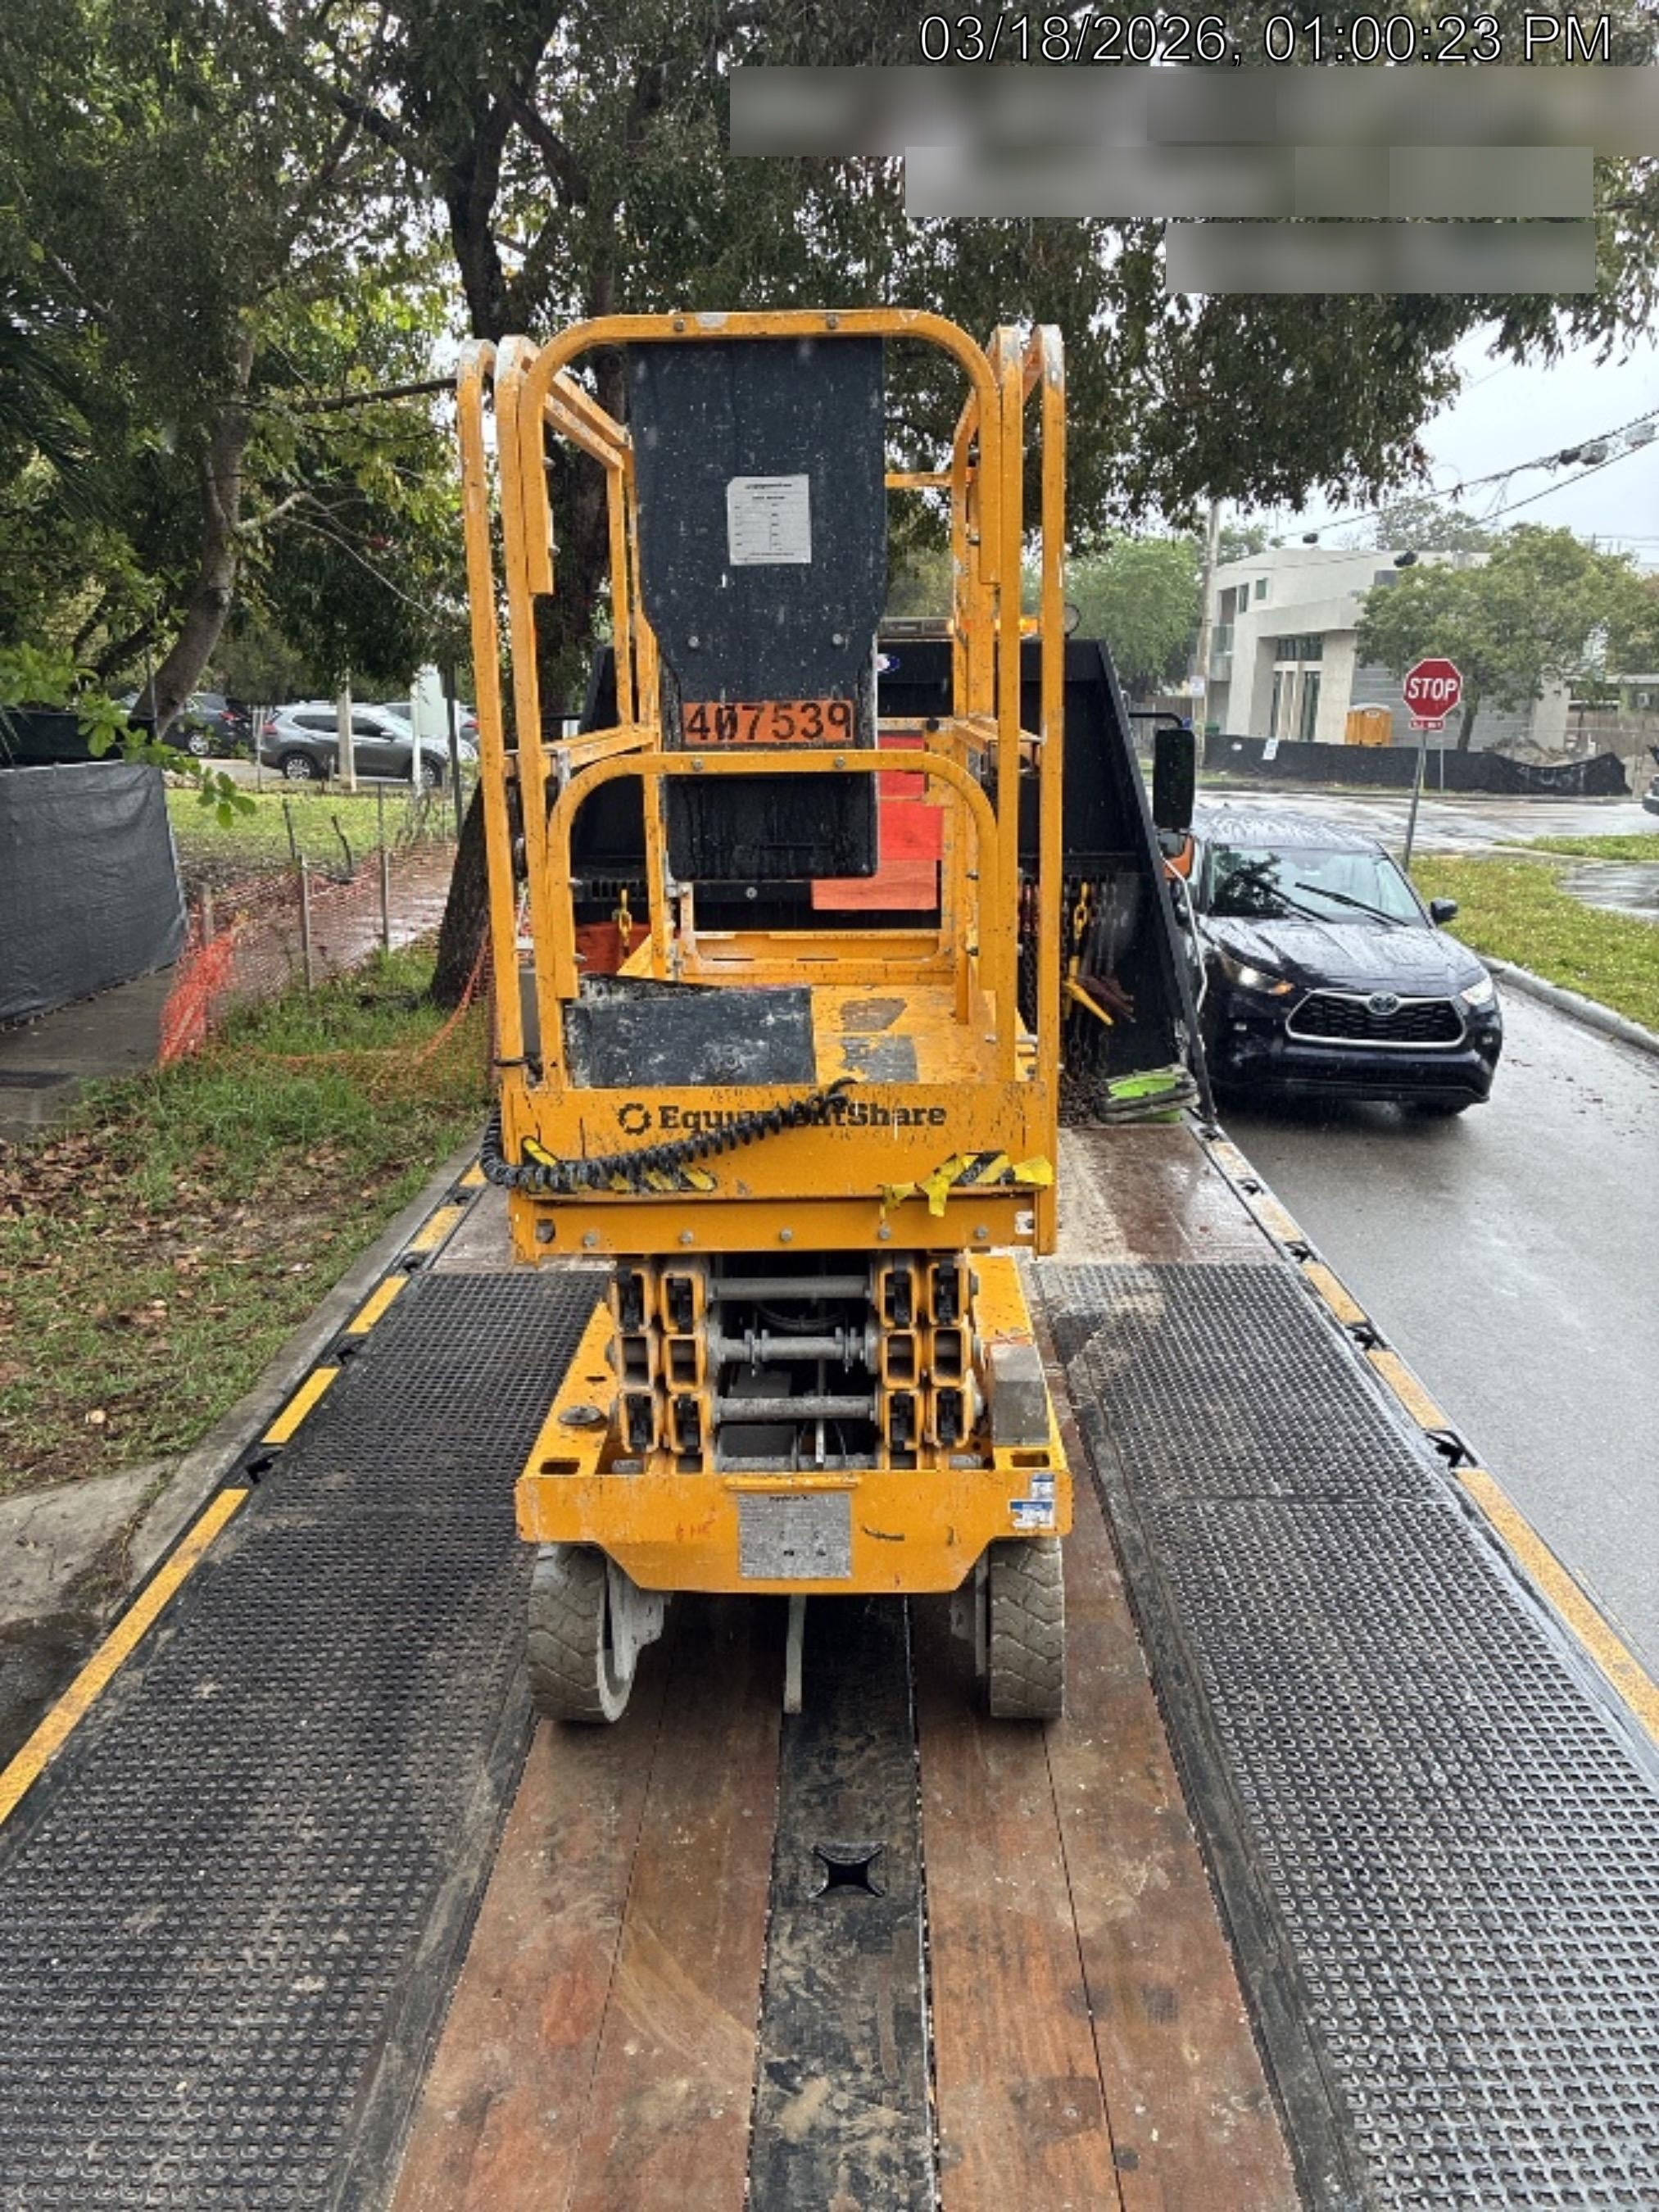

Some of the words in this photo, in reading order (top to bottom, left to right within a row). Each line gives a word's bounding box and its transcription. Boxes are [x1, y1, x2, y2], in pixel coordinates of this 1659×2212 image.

[1407, 678, 1457, 700] STOP
[687, 702, 852, 741] 407539
[658, 1102, 947, 1134] EquientShare
